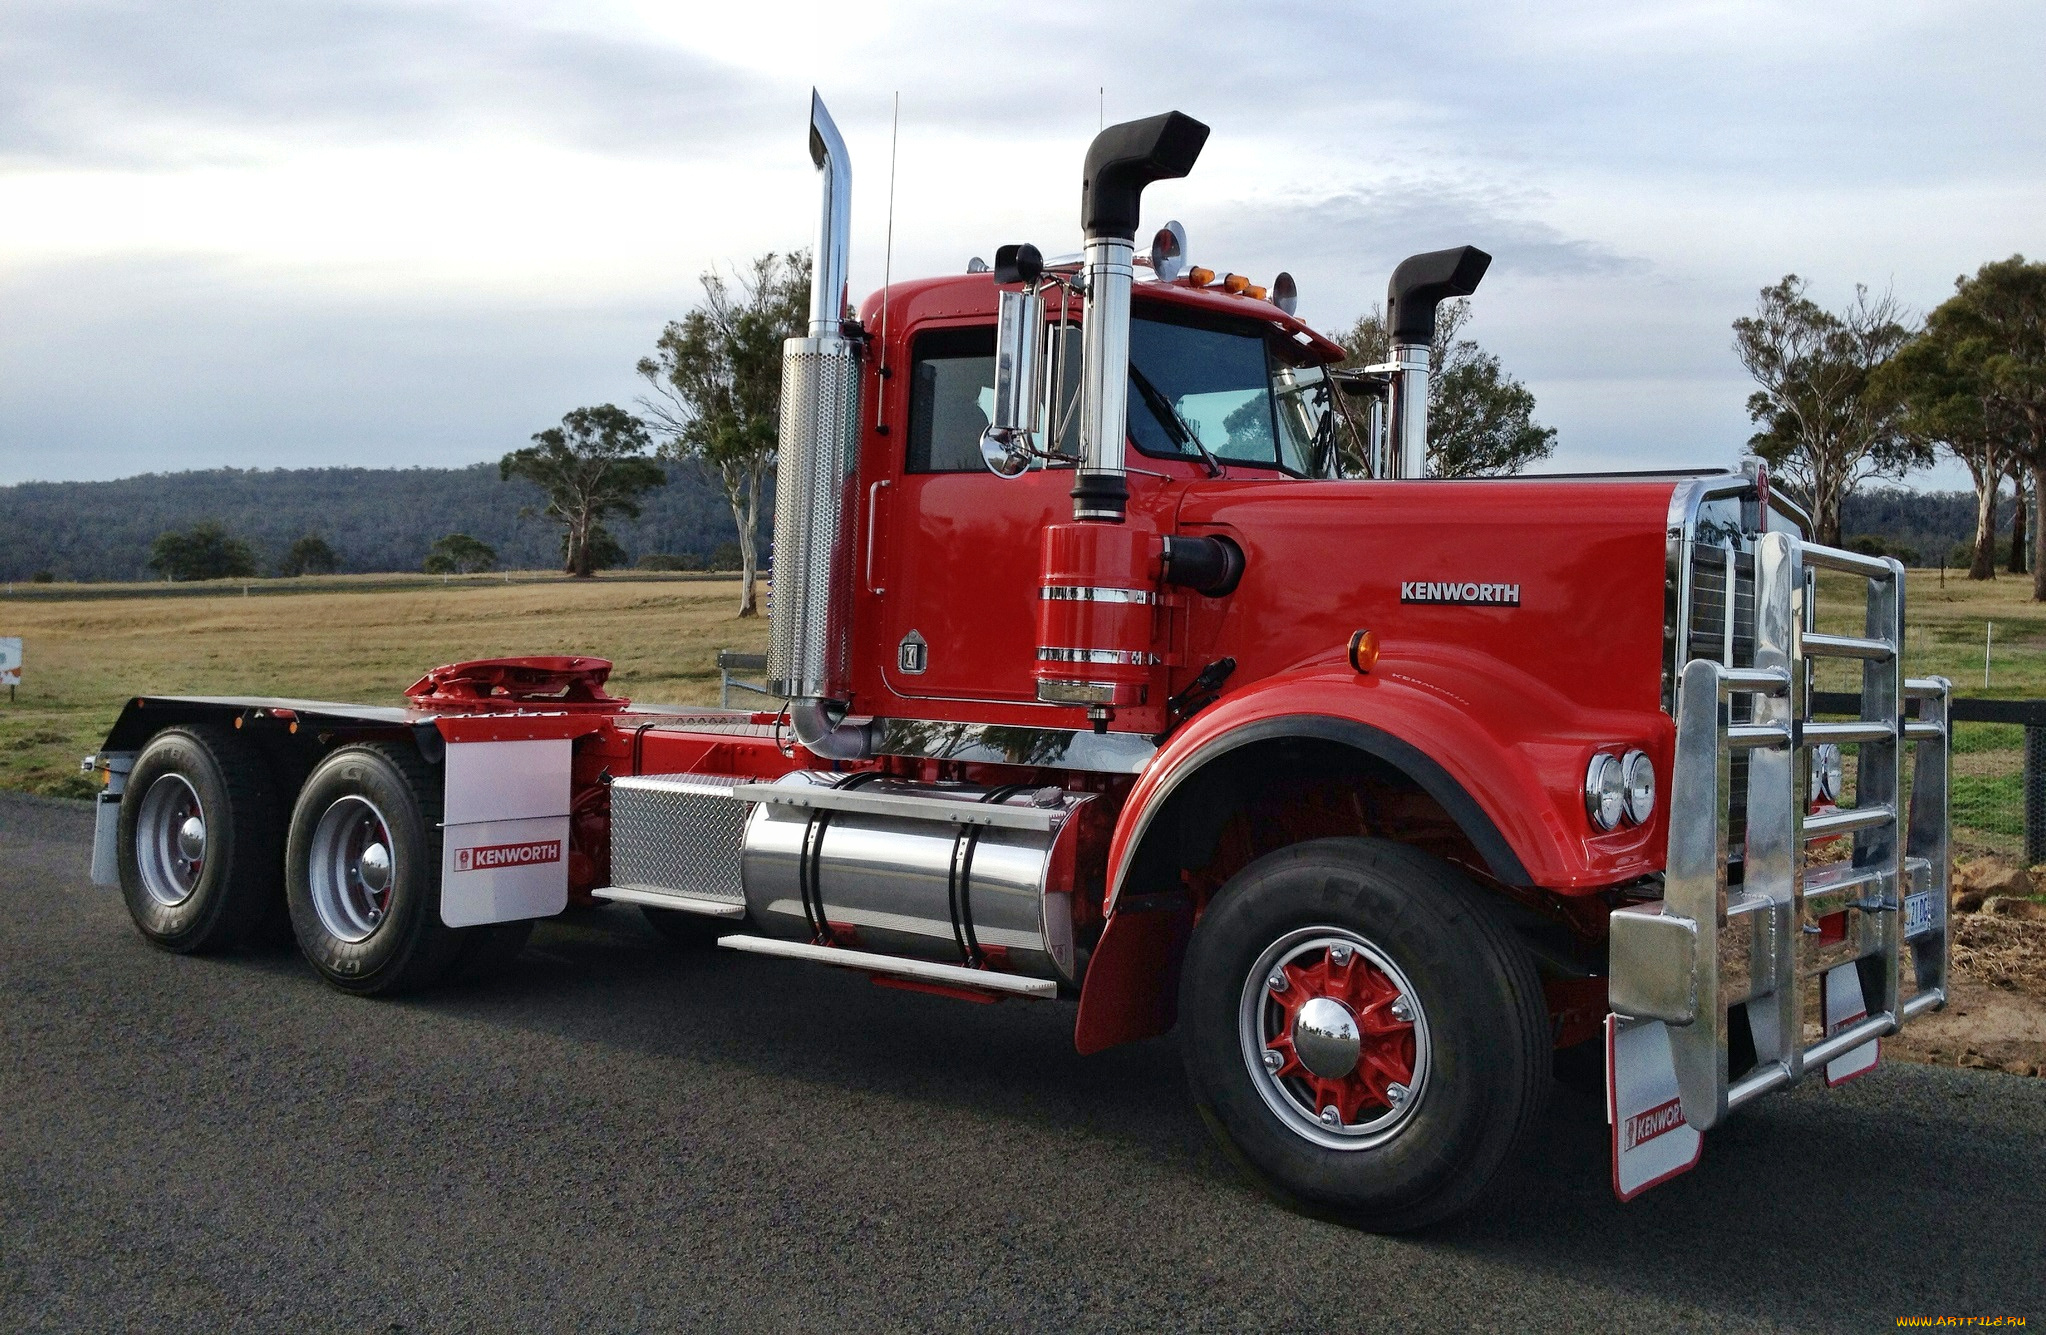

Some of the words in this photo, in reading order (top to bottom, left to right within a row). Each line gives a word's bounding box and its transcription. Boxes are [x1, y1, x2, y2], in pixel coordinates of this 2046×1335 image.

[1401, 581, 1520, 604] KENWORTH
[475, 844, 558, 866] KENWORTH
[1637, 1103, 1684, 1140] KENWOR
